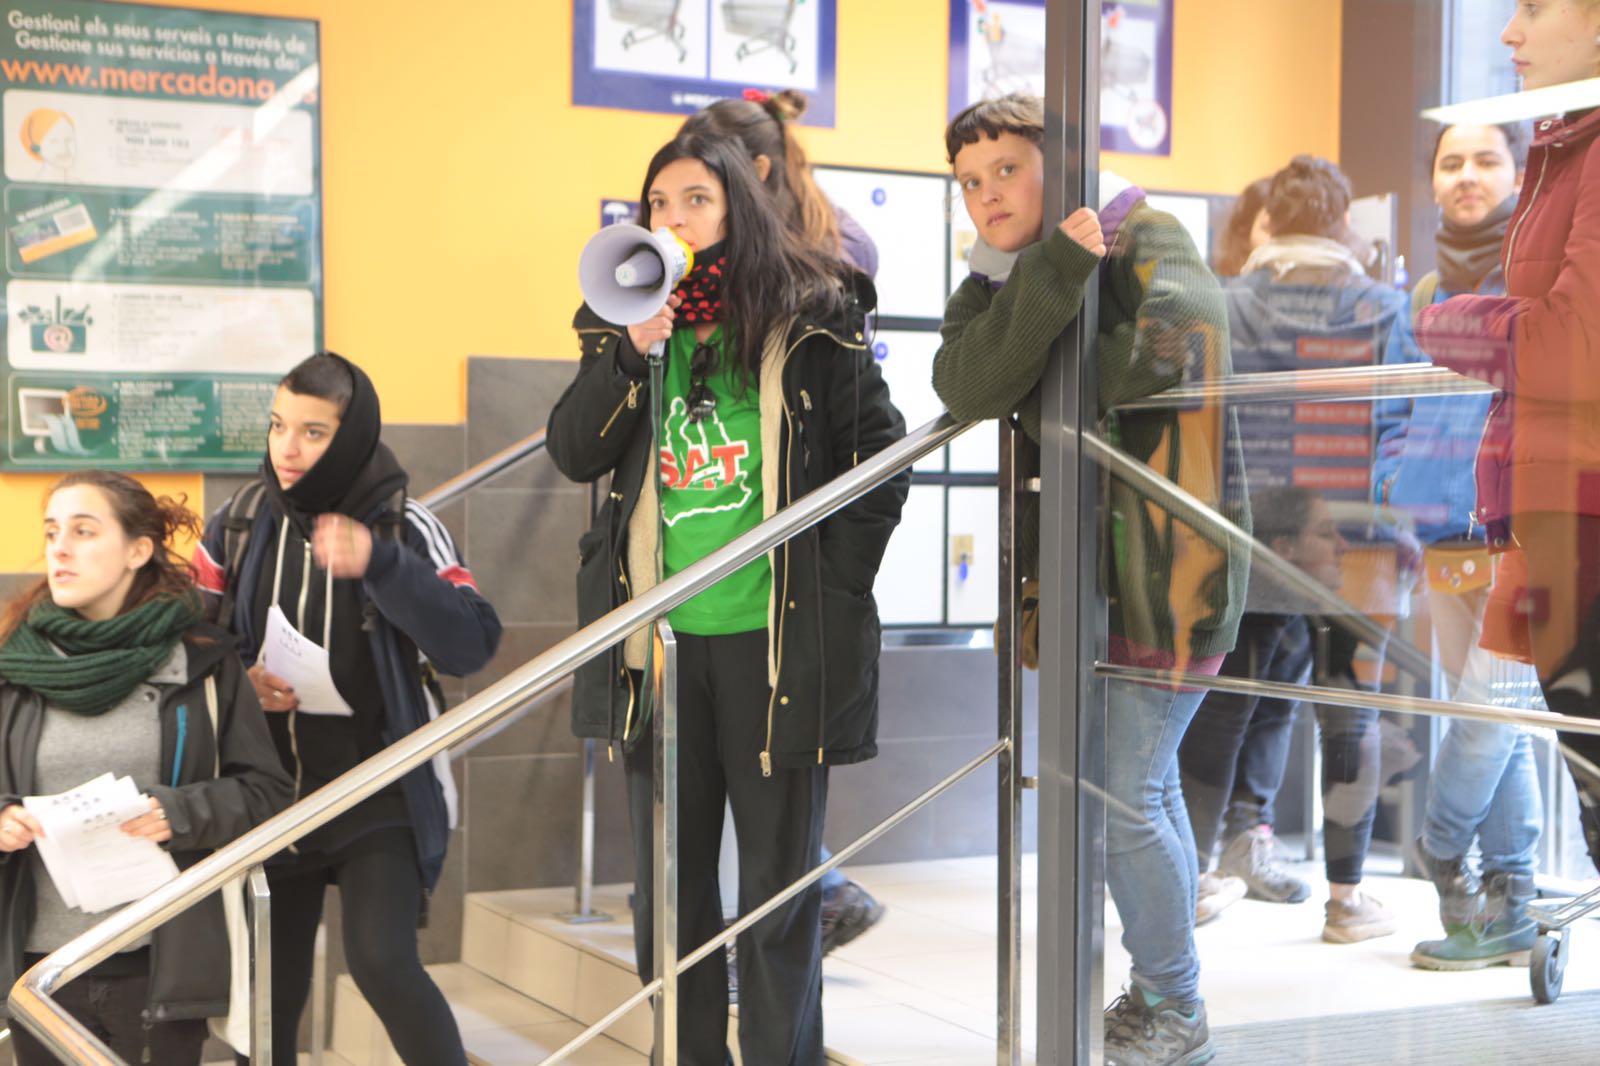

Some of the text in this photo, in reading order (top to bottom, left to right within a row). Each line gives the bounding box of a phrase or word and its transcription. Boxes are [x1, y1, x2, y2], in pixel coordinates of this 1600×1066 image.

[8, 9, 80, 34] Gestioni
[84, 15, 108, 36] els
[113, 23, 150, 41] seus
[155, 26, 212, 46] serveis
[216, 32, 228, 46] a
[232, 31, 281, 51] través
[15, 30, 92, 55] Gestione
[97, 41, 124, 58] sus
[128, 43, 200, 63] servicios
[205, 50, 217, 64] a
[221, 49, 271, 69] través
